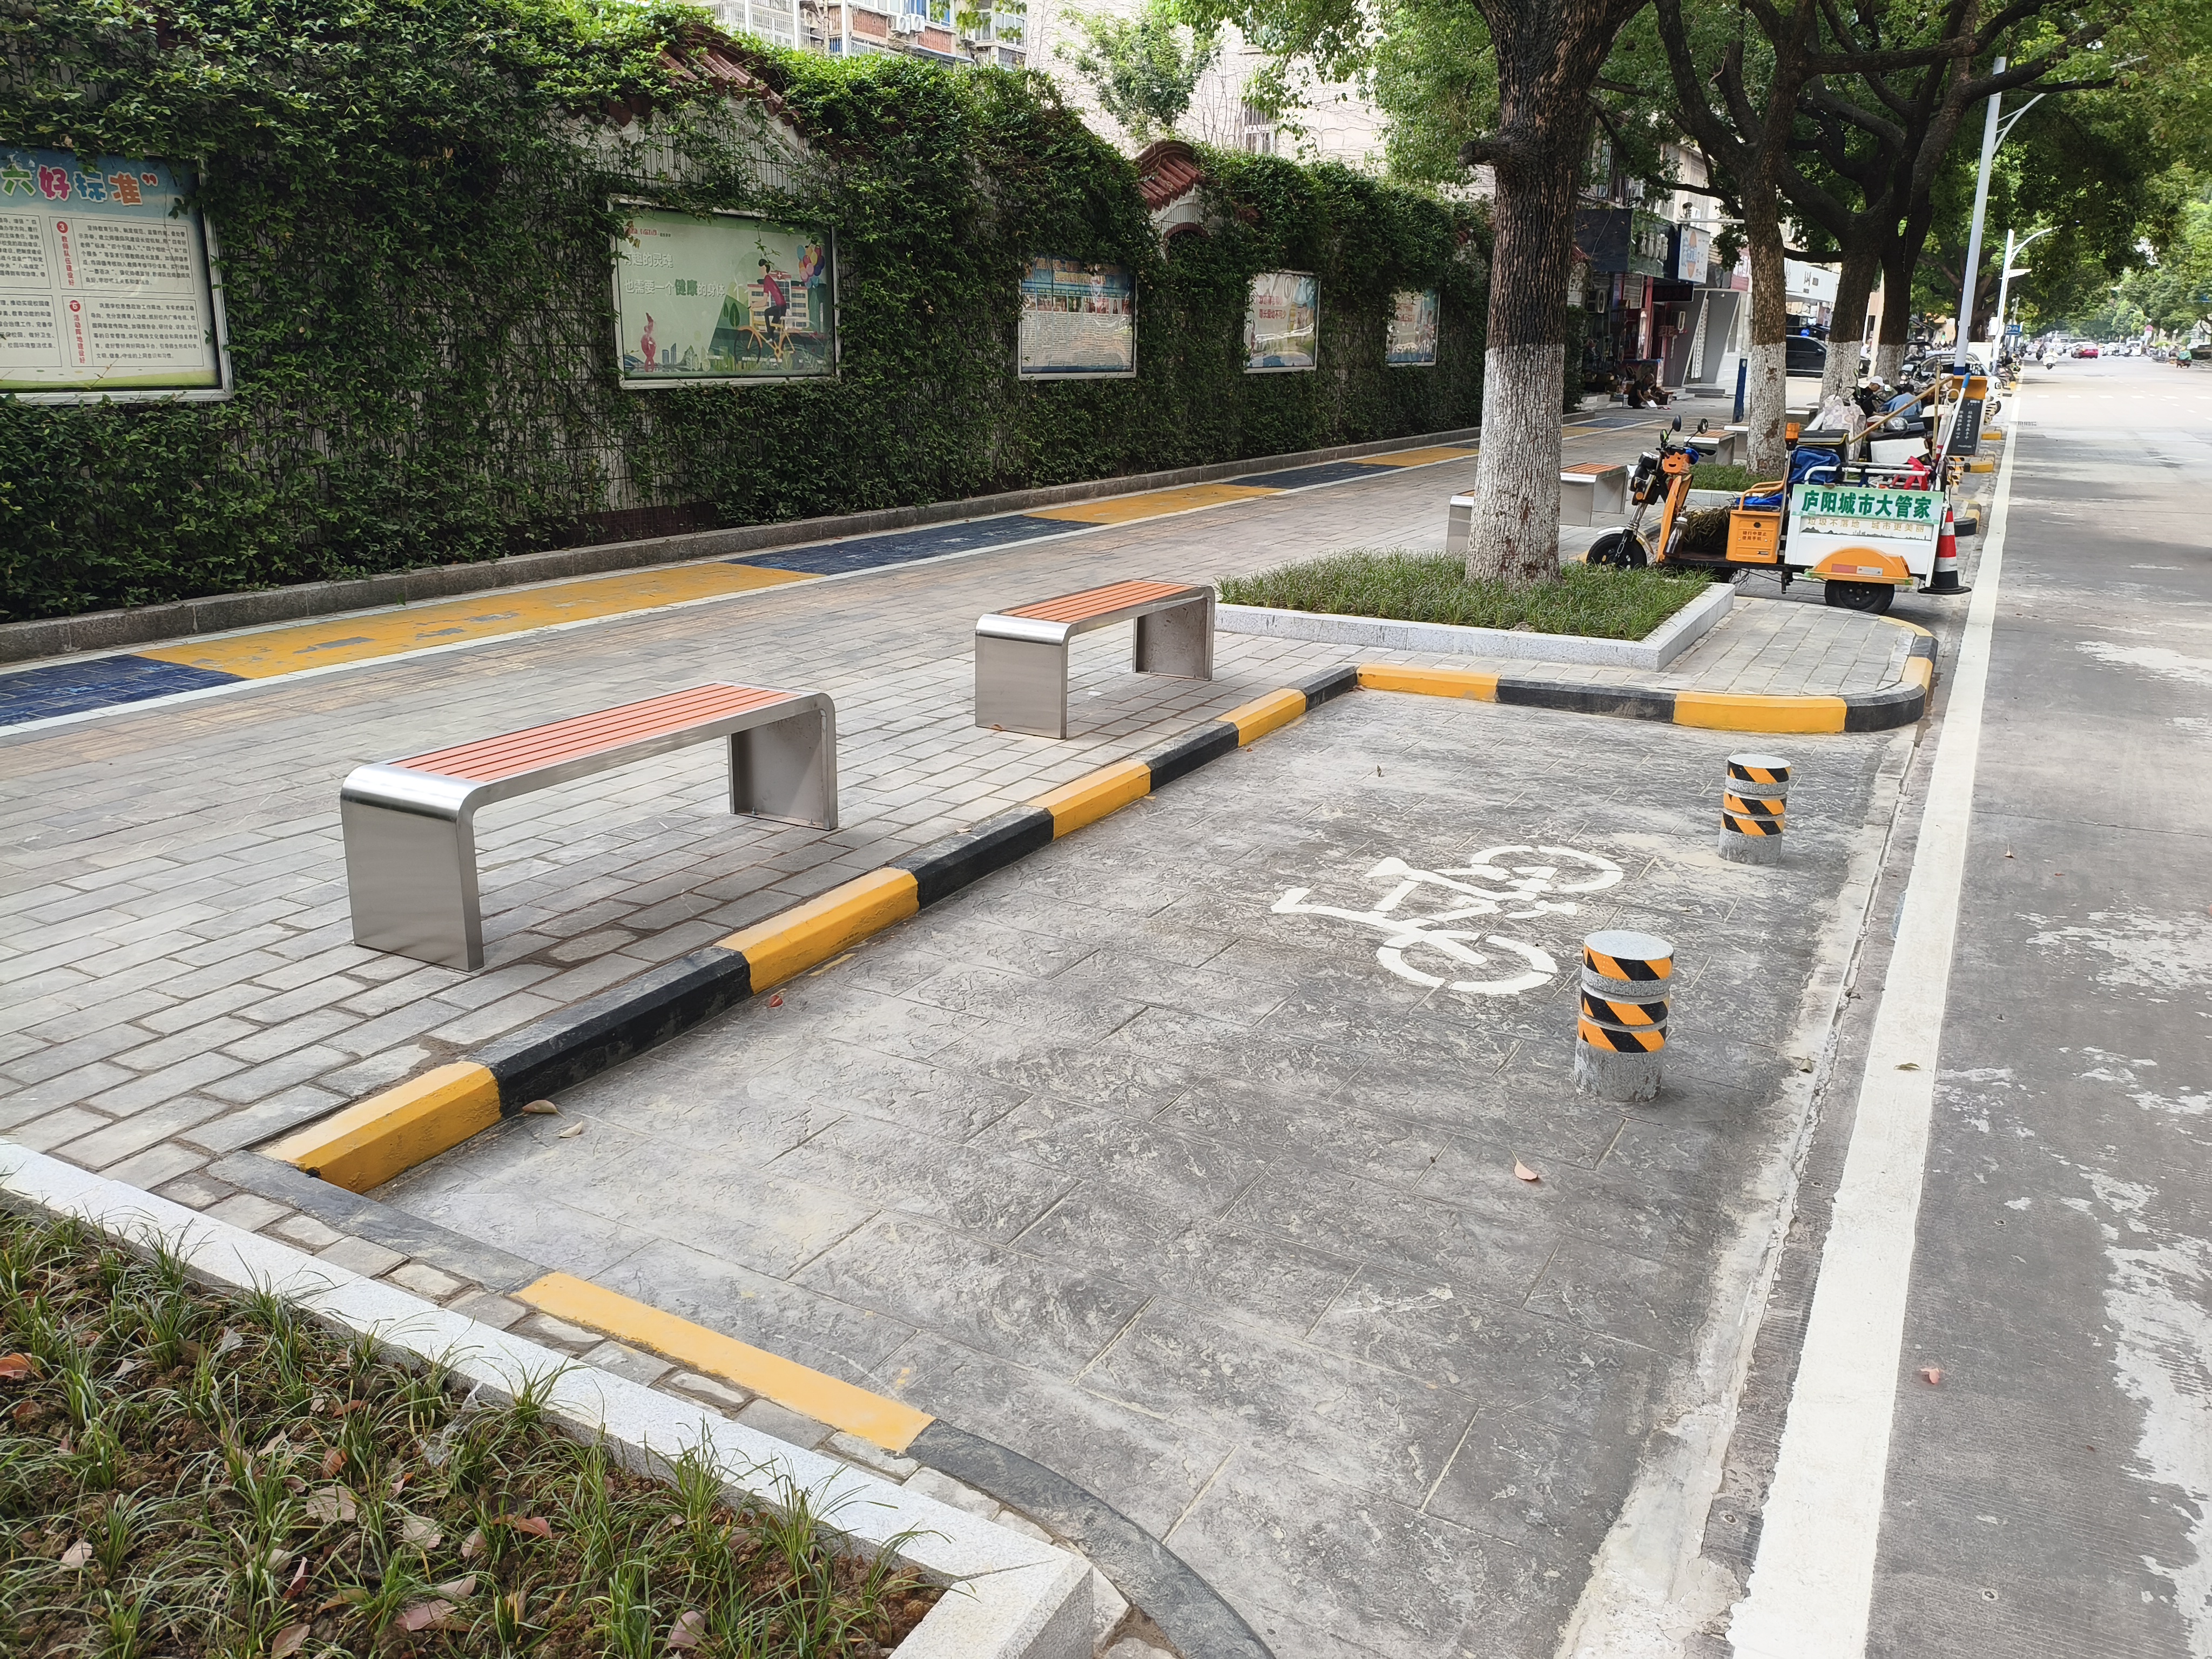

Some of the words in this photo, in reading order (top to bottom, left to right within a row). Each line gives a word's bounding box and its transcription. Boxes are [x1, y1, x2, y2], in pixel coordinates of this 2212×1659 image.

[59, 223, 65, 231] 3
[625, 252, 673, 268] 有趣的灵魂
[624, 279, 725, 297] 也需要一个健康的身体
[1802, 490, 1932, 519] 庐阳城市大管家
[1808, 517, 1860, 528] 垃圾不落地
[1871, 521, 1925, 532] 城市更美丽
